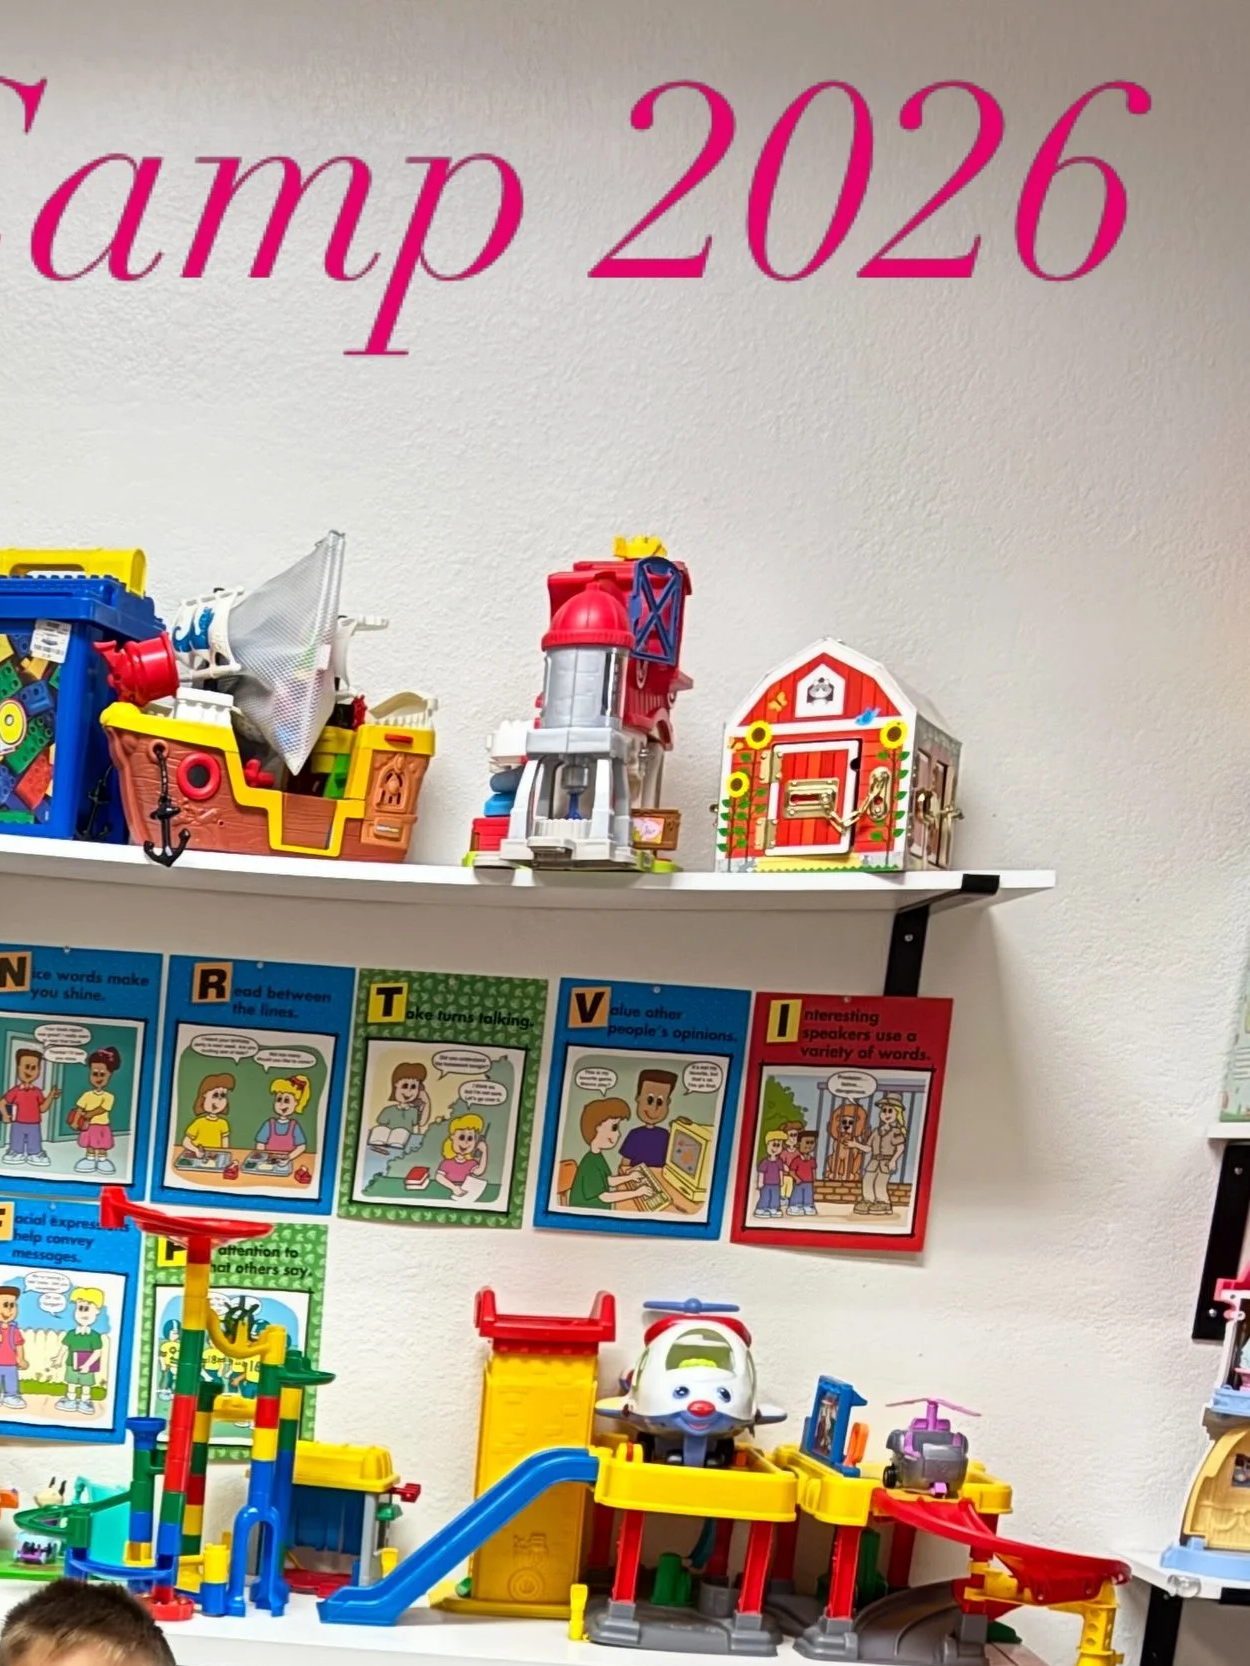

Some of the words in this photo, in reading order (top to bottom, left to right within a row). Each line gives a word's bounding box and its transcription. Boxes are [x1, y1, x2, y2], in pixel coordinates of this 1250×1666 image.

[56, 970, 103, 985] words
[107, 972, 150, 987] make
[30, 987, 59, 1001] you
[63, 986, 106, 1002] shine.
[267, 985, 332, 1003] between
[232, 1001, 256, 1016] the
[261, 1003, 299, 1019] lines.
[645, 1006, 684, 1021] other
[437, 1010, 474, 1024] turns
[479, 1010, 534, 1028] talking.
[608, 1023, 669, 1038] people's
[672, 1026, 738, 1043] opinions.
[802, 1026, 871, 1041] speakers
[876, 1031, 901, 1042] use
[906, 1032, 917, 1043] a
[800, 1045, 851, 1062] variety
[857, 1045, 875, 1060] of
[878, 1046, 932, 1062] words.
[14, 1228, 42, 1246] help
[46, 1235, 95, 1251] convey
[11, 1249, 83, 1265] messages.
[218, 1243, 281, 1259] attention
[285, 1247, 299, 1259] to
[235, 1263, 279, 1276] others
[283, 1265, 313, 1280] say.
